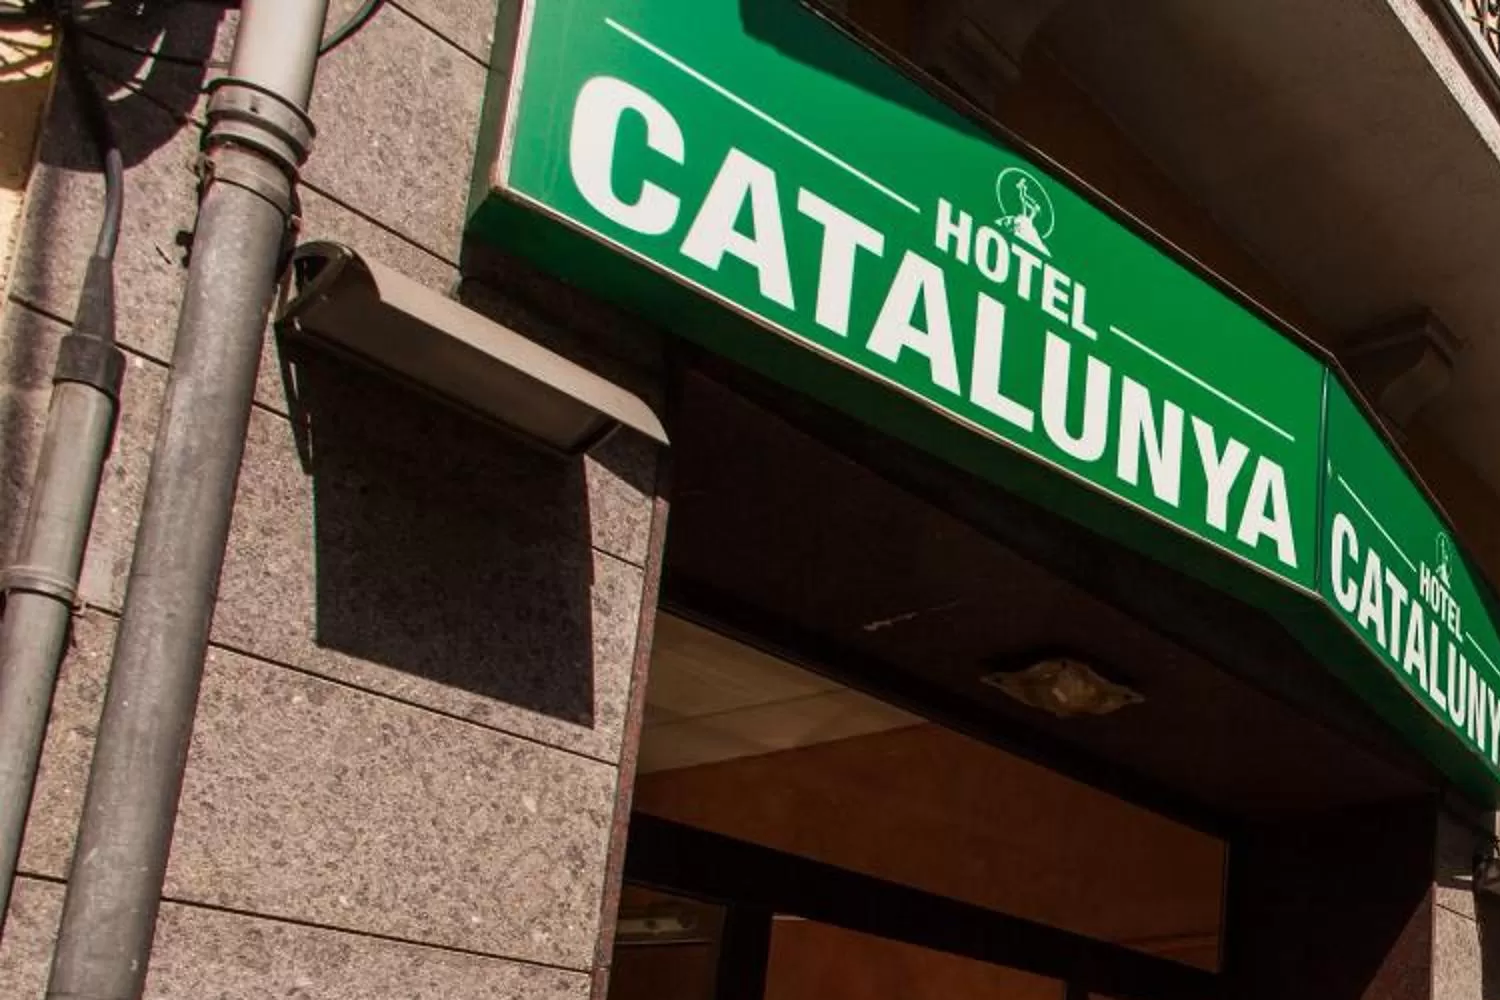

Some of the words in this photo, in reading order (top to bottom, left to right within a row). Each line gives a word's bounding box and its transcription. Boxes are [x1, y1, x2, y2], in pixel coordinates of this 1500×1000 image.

[568, 76, 1299, 569] CATALUNYA
[936, 197, 1099, 340] HOTEL
[1419, 560, 1464, 643] HOTEL
